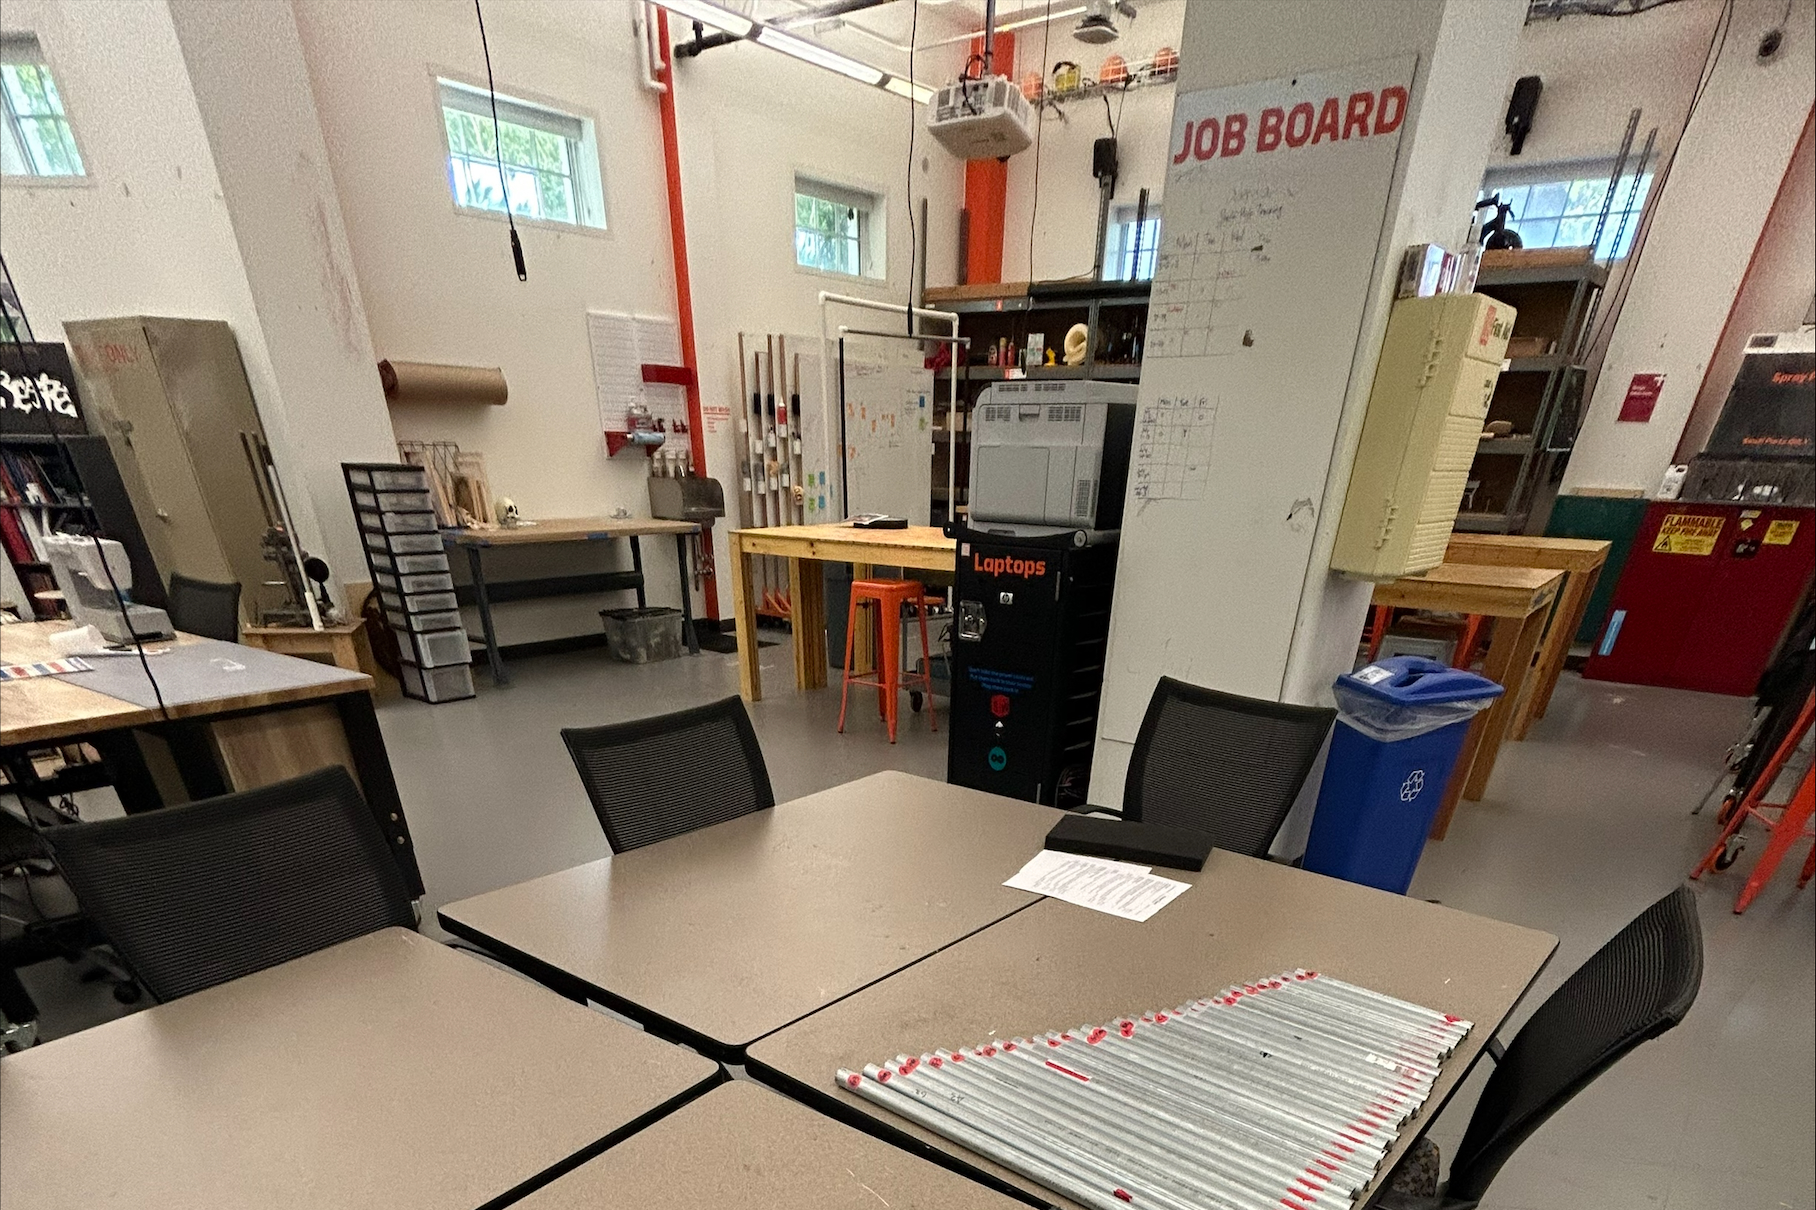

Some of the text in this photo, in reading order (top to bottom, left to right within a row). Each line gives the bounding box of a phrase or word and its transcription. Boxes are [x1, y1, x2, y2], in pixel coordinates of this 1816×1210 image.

[1173, 86, 1408, 165] JOB BOARD
[1664, 515, 1724, 528] FLAMMABLE
[1661, 526, 1719, 538] KEEP FIRE AWAY
[974, 552, 1046, 579] Laptops
